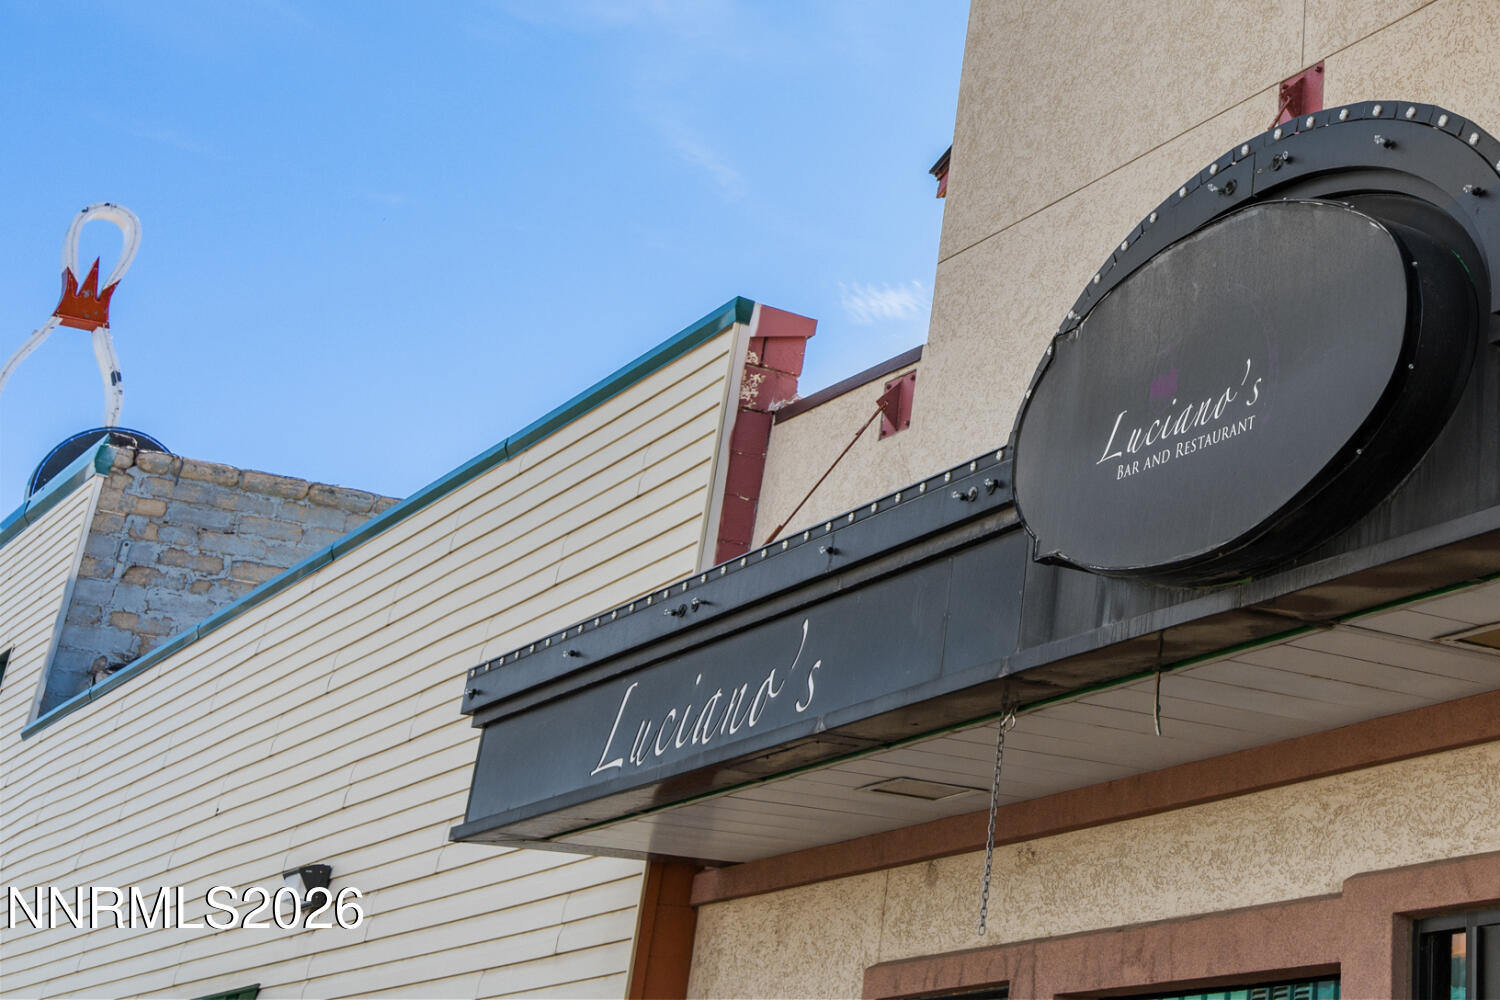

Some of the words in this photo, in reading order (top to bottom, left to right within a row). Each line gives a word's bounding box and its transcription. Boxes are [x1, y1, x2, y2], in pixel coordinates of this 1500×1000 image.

[1096, 358, 1262, 464] Luciano's
[1116, 461, 1139, 480] BAR
[1143, 449, 1170, 471] AND
[1175, 415, 1256, 458] RESTAURANT
[590, 618, 821, 776] Luciano's
